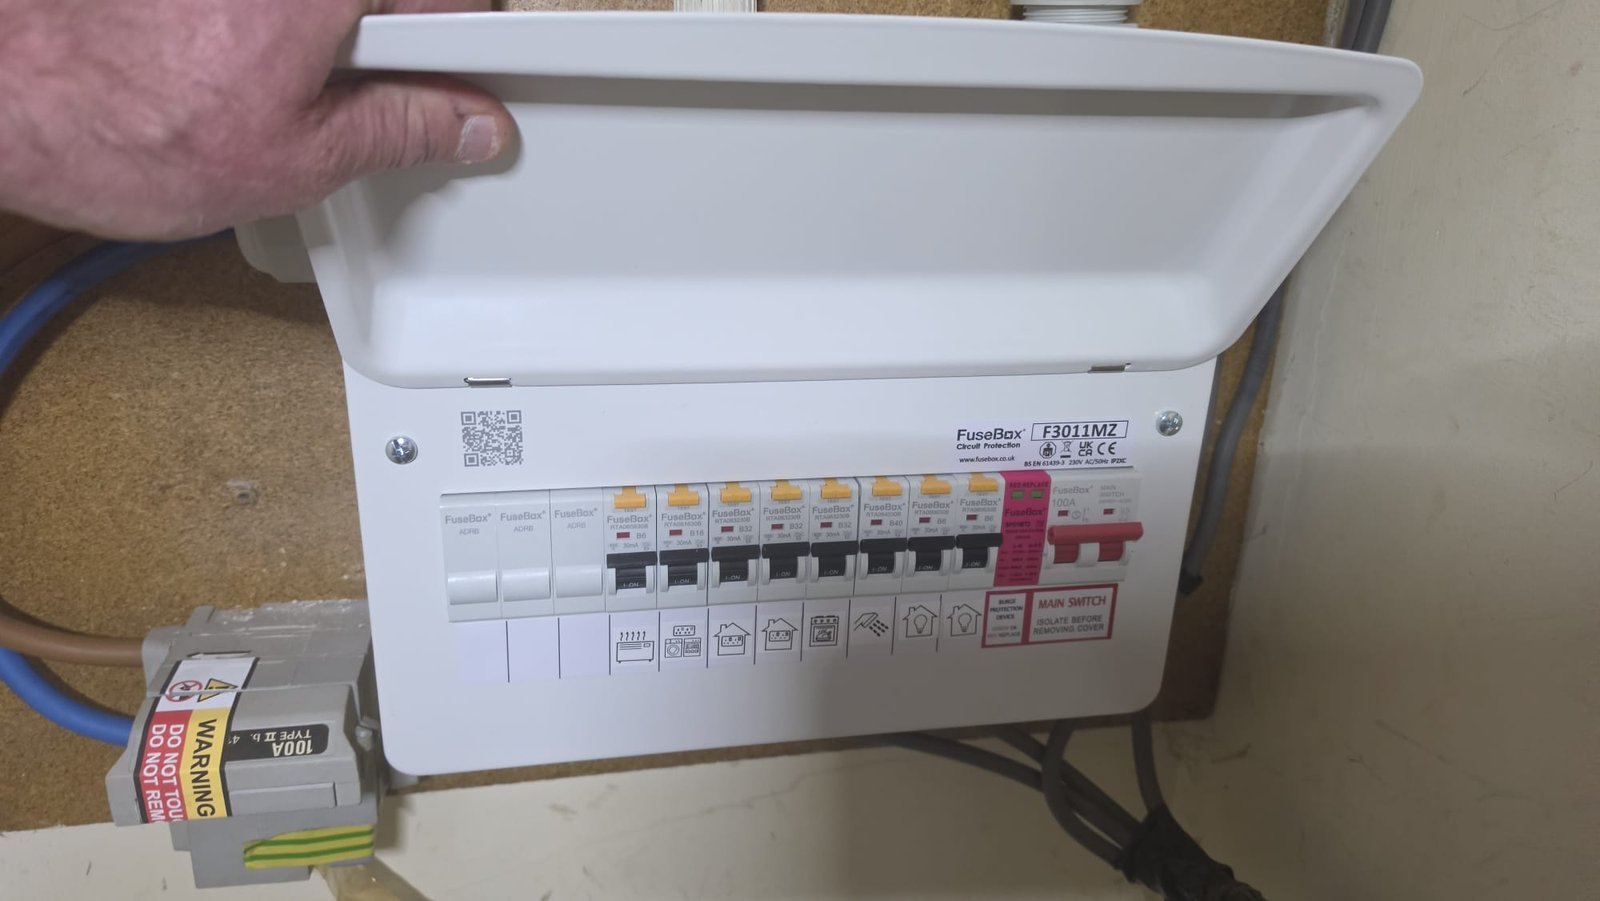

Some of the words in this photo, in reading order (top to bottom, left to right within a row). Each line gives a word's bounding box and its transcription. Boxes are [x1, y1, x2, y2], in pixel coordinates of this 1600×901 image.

[957, 428, 1022, 441] FuseBox
[1042, 424, 1118, 438] F3011MZ
[1097, 442, 1117, 455] CE
[959, 454, 1015, 463] www.fusebox.co.uk
[1053, 486, 1090, 495] FuseBox
[864, 503, 902, 511] FuseBox
[912, 501, 950, 509] FuseBox
[960, 498, 998, 506] FuseBox
[1052, 498, 1076, 507] 100A
[554, 508, 594, 518] FuseBox
[712, 508, 751, 517] FuseBox
[763, 506, 802, 515] FuseBox
[812, 505, 851, 514] FuseBox
[445, 514, 488, 524] FuseBox
[500, 511, 543, 522] FuseBox
[607, 515, 649, 524] FuseBox
[662, 512, 703, 521] FuseBox
[1038, 599, 1065, 609] MAIN
[1068, 596, 1106, 608] SWITCH
[1036, 616, 1069, 625] ISOLATE
[1072, 614, 1103, 623] BEFORE
[1033, 626, 1075, 635] REMOVING
[1077, 623, 1104, 632] COVER
[149, 724, 167, 748] DO
[167, 724, 185, 748] DO
[280, 729, 312, 740] TYPE
[272, 740, 313, 757] 100A
[143, 752, 161, 786] NOT
[161, 752, 179, 786] NOT
[190, 719, 218, 817] WARNING
[146, 790, 166, 822] REM
[165, 789, 183, 822] TOU
